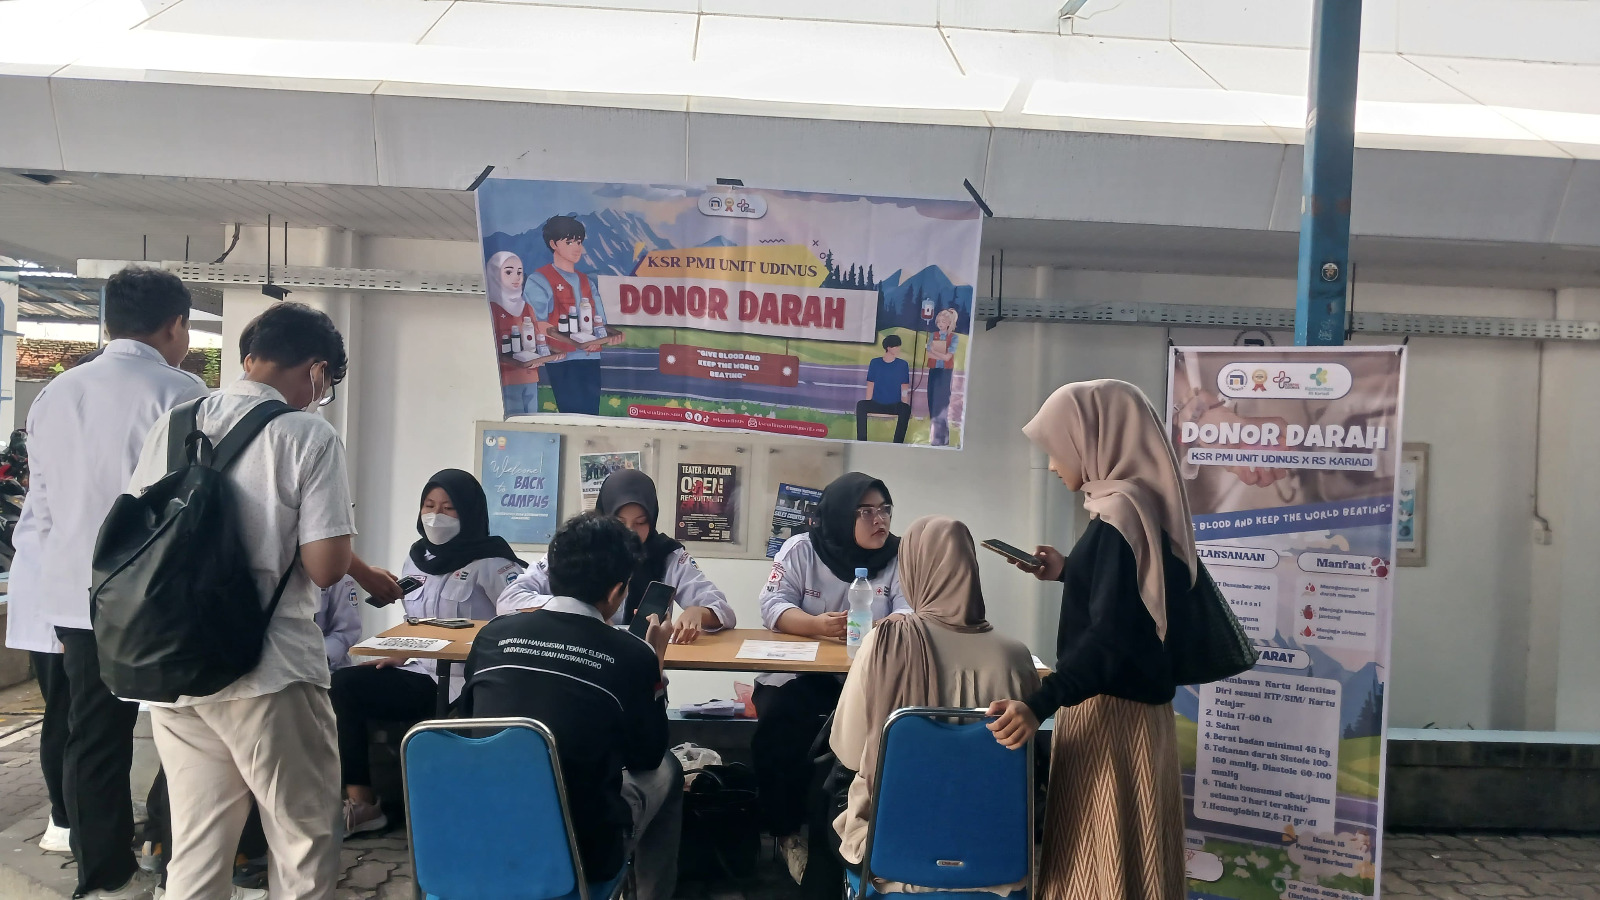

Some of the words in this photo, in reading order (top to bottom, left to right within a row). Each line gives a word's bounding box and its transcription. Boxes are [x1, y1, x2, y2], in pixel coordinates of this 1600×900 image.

[648, 256, 681, 268] KSR
[686, 256, 715, 270] PMI
[720, 259, 756, 272] UNIT
[760, 261, 818, 277] UDINUS
[620, 283, 729, 322] DONOR
[738, 290, 846, 330] DARAH
[718, 352, 744, 360] BLOOD
[745, 354, 760, 362] AND
[733, 363, 759, 371] WORLD
[1182, 422, 1280, 446] DONOR
[1286, 424, 1386, 449] DARAH
[1191, 452, 1212, 461] KSR
[1215, 454, 1233, 462] PMI
[1236, 454, 1259, 462] UNIT
[1262, 455, 1299, 464] UDINUS
[1302, 456, 1309, 464] X
[1312, 456, 1326, 465] RS
[1329, 457, 1373, 466] KARIADI
[682, 466, 701, 474] TEATER
[708, 467, 732, 475] KAPLINK
[494, 482, 506, 492] to
[514, 476, 545, 490] BACK
[681, 476, 723, 494] OPEN
[501, 494, 549, 508] CAMPUS
[1200, 520, 1231, 530] BLOOD
[1234, 518, 1252, 528] AND
[1256, 515, 1280, 524] KEEP
[1282, 513, 1301, 522] THE
[1305, 510, 1339, 520] WORLD
[1343, 504, 1391, 516] BEATING"
[1196, 549, 1265, 561] ELAKSANAAN
[1316, 558, 1366, 570] Manfaat
[503, 646, 540, 656] UNIVERSITAS
[541, 650, 557, 658] DIAN
[557, 653, 602, 669] NUSWANTORO
[528, 640, 565, 650] MAHASISWA
[566, 644, 587, 654] TEKNIK
[589, 650, 615, 664] ELEKTRO
[1258, 651, 1295, 663] ARAT
[1220, 677, 1260, 686] embawa
[1265, 681, 1290, 690] Kartu
[1296, 683, 1336, 695] Identitas
[1215, 698, 1245, 709] Pelajar
[1216, 686, 1231, 695] Diri
[1235, 690, 1261, 699] sesuai
[1308, 698, 1336, 707] Kartu
[1217, 710, 1234, 719] Usia
[1237, 713, 1260, 721] 17-60
[1262, 716, 1272, 724] th
[1216, 722, 1240, 731] Sehat
[1213, 733, 1236, 742] Berat
[1239, 737, 1264, 746] badan
[1266, 741, 1302, 751] minimal
[1319, 748, 1330, 758] kg
[1213, 745, 1249, 756] Tekanan
[1252, 750, 1277, 760] darah
[1280, 754, 1310, 765] Sistole
[1212, 757, 1226, 765] 160
[1262, 764, 1297, 775] Diastole
[1300, 768, 1331, 780] 60-100
[1212, 769, 1239, 780] mmHg
[1214, 780, 1237, 790] Tidak
[1240, 784, 1282, 796] konsumsi
[1285, 791, 1330, 804] obat/jamu
[1210, 791, 1239, 802] selama
[1248, 797, 1267, 806] hari
[1270, 800, 1308, 813] terakhir
[1210, 802, 1260, 817] Hemoglobin
[1294, 818, 1316, 826] gr/dl
[1312, 836, 1335, 846] Untuk
[1296, 843, 1330, 854] Pendonor
[1332, 850, 1363, 860] Pertama
[1303, 854, 1320, 864] Yang
